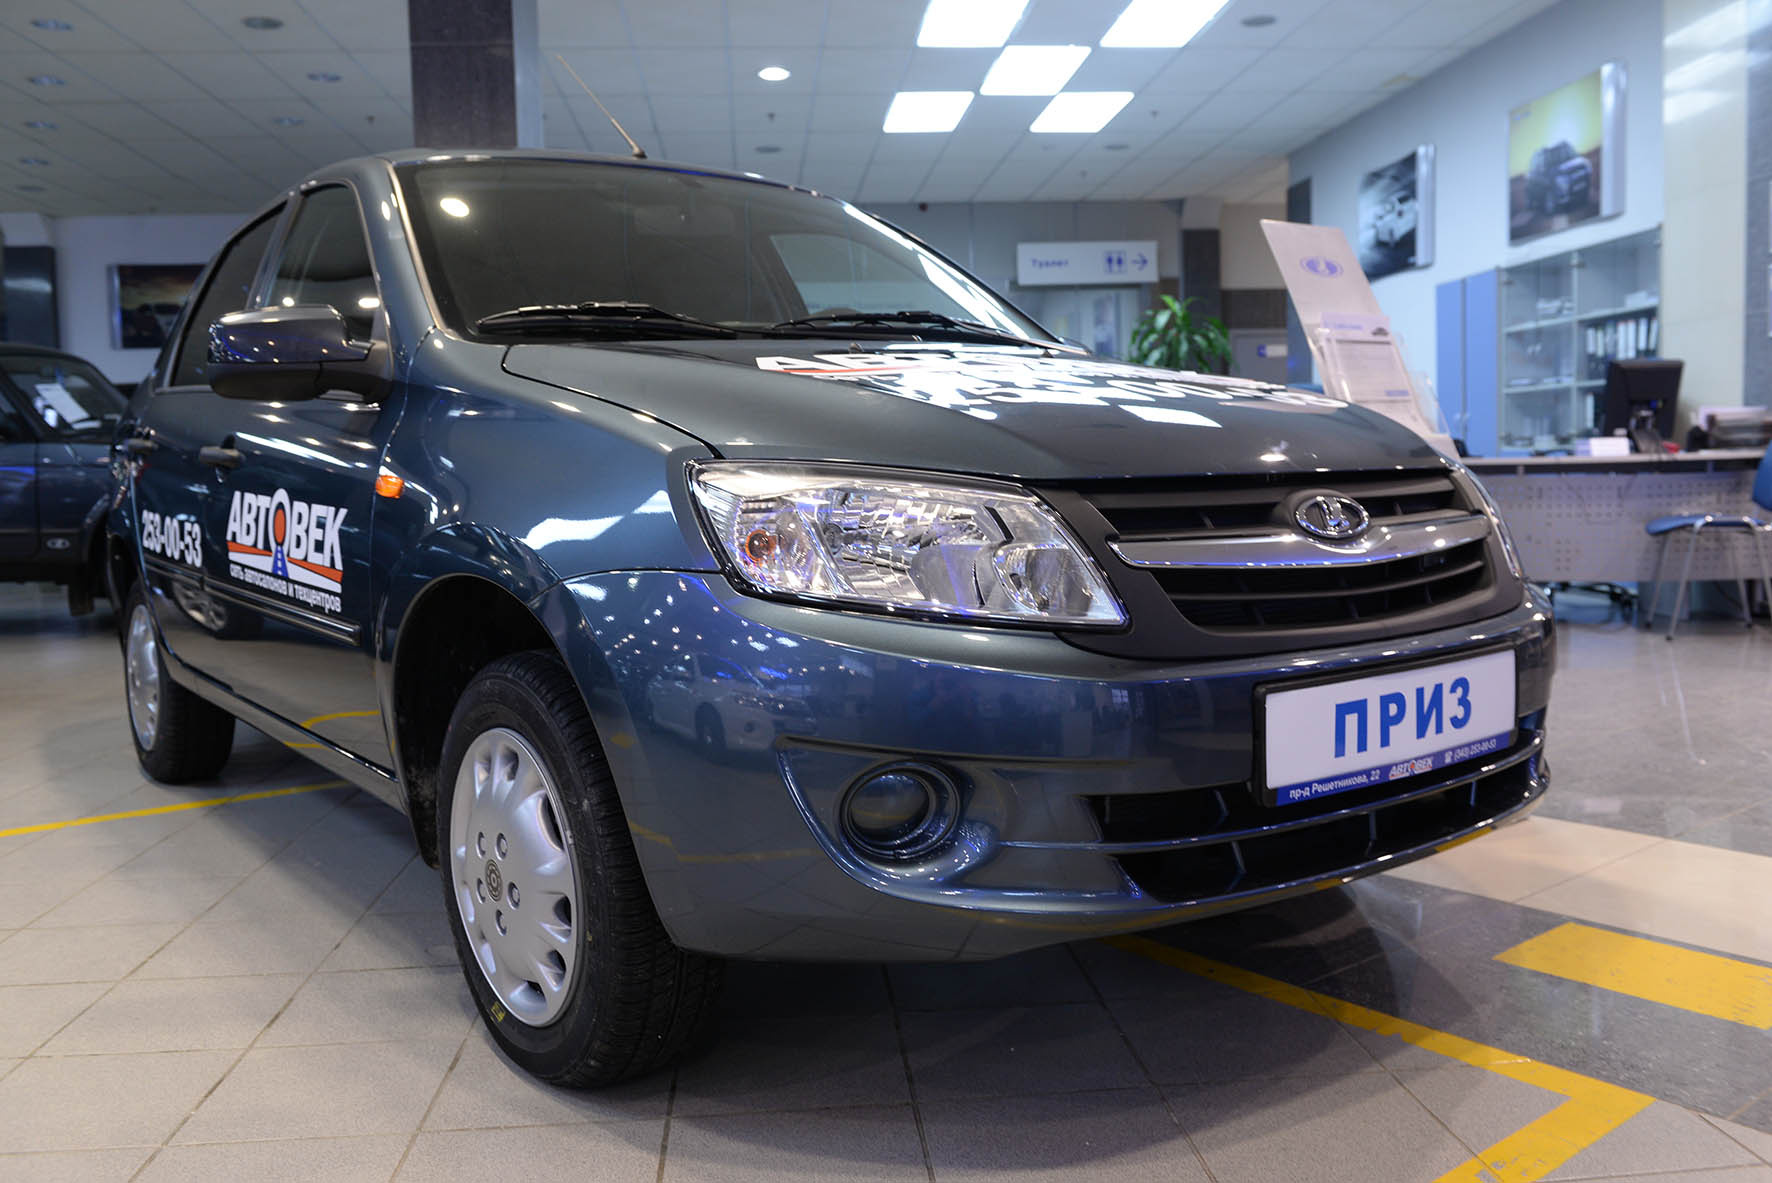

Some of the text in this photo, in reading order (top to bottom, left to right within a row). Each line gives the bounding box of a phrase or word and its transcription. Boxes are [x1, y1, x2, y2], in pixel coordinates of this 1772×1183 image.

[142, 509, 202, 568] 253-00-53
[226, 488, 348, 570] АВТОВЕК
[244, 567, 287, 596] автосалонов
[295, 584, 342, 614] техцентров
[1334, 676, 1472, 759] ПРИЗ
[1289, 769, 1381, 800] пр-д Решетникова, 22
[1389, 757, 1433, 779] АВТОВЕК
